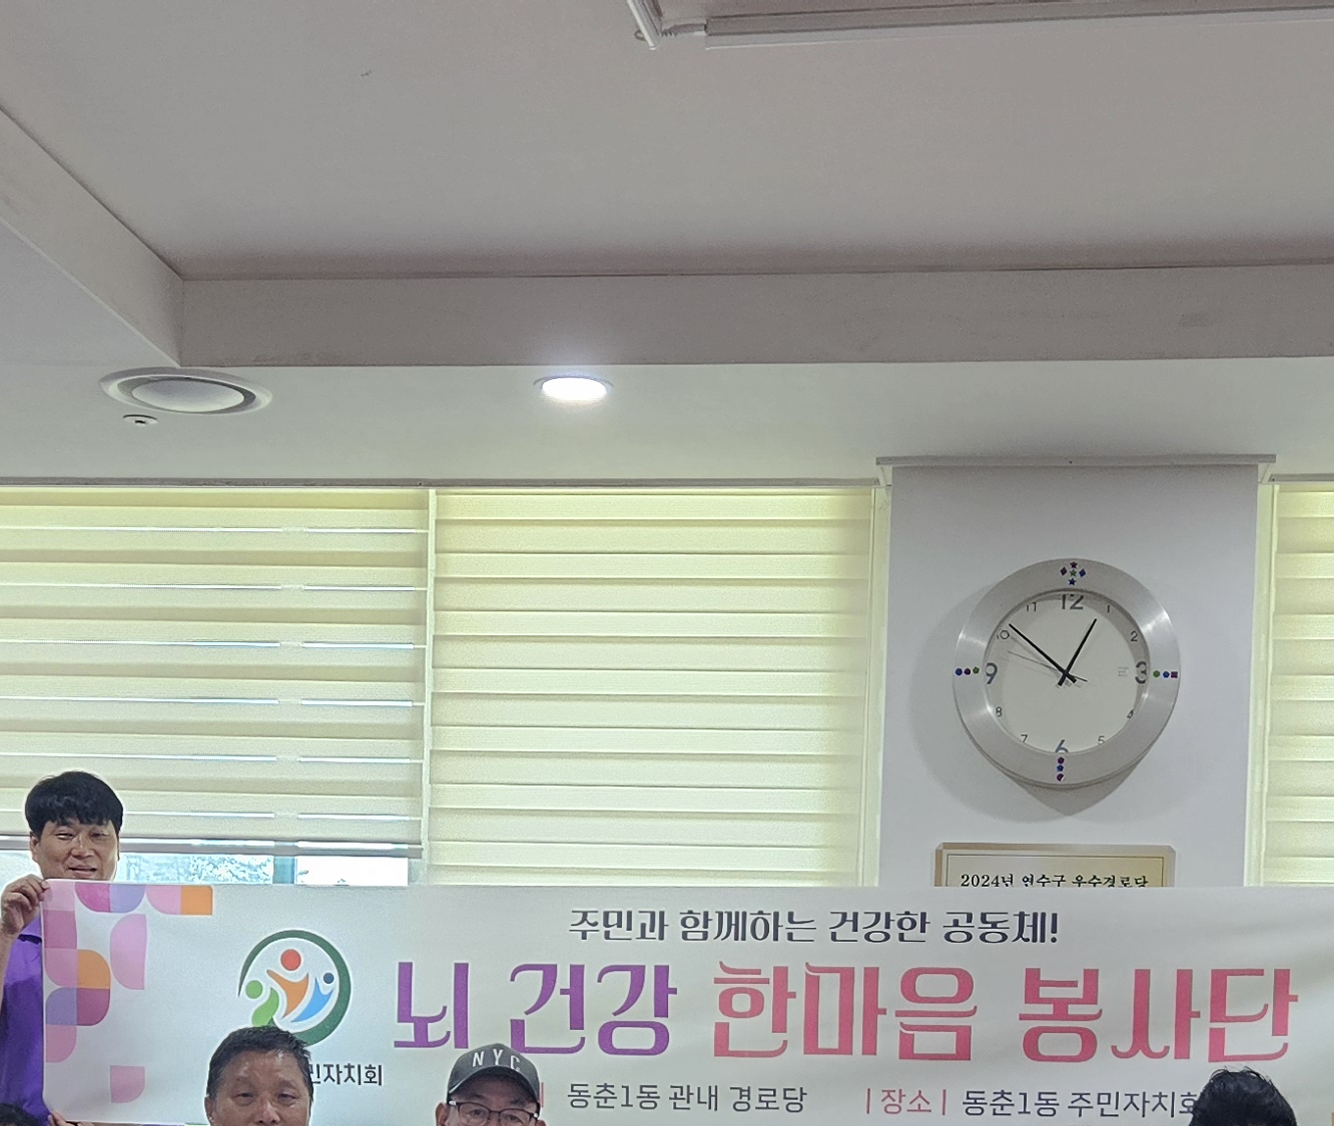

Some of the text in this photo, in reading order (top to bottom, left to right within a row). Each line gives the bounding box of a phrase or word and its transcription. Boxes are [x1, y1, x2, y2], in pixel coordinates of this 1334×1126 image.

[1061, 594, 1085, 610] 12
[1130, 631, 1138, 642] 2
[985, 662, 998, 685] 9
[1135, 661, 1148, 684] 3
[995, 706, 1003, 717] 8
[1020, 734, 1028, 744] 7
[568, 909, 1059, 944] 주민과 함께하는 건강한 공동체!
[393, 961, 1299, 1063] 뇌 건강 한마음 봉사단
[472, 1048, 521, 1073] NYC
[567, 1083, 808, 1113] 동춘1동 관내 경로당
[880, 1088, 933, 1115] 장소
[962, 1090, 1061, 1117] 동춘1동
